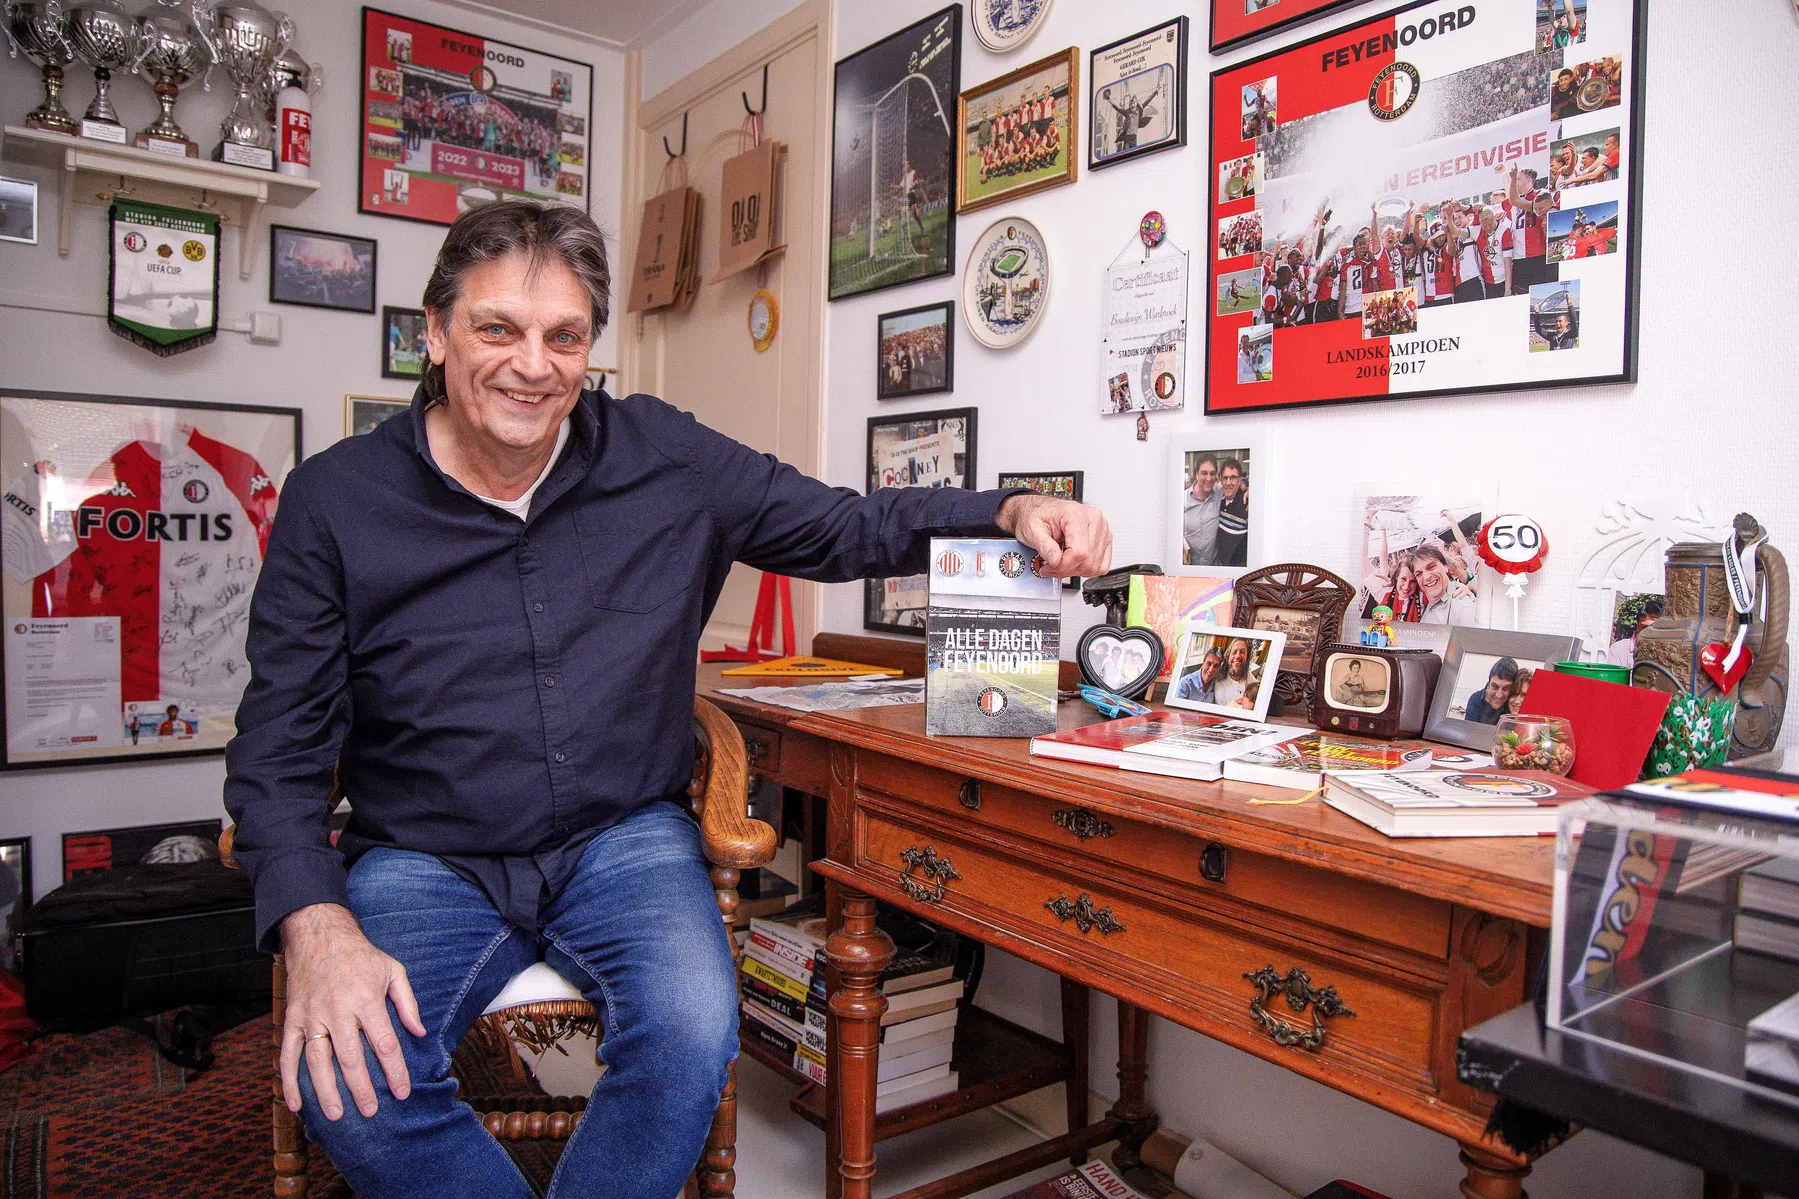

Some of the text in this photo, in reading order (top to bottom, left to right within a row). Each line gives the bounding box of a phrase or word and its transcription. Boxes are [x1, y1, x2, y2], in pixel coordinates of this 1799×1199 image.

[1322, 5, 1477, 73] FEYENOORD
[441, 38, 525, 68] FEYENOORD
[1372, 62, 1417, 89] FEYENOORD
[1371, 93, 1417, 119] ROTTERDAM
[437, 150, 520, 176] 2022 2023
[1406, 130, 1549, 188] EREDIVISIE
[147, 263, 182, 274] UEFA CUP
[1113, 267, 1179, 292] Certificaat
[1118, 347, 1139, 359] STADION
[1326, 336, 1461, 364] LANDSKAMPIOEN
[1355, 360, 1426, 379] 2016/2017
[882, 455, 940, 488] COCKNEY
[3, 491, 37, 518] RTIS
[78, 505, 233, 542] FORTIS
[1490, 524, 1540, 551] 50
[944, 627, 1043, 652] ALLE DAGEN
[943, 650, 1043, 676] FEYENOORD
[773, 943, 807, 968] INSIDE
[770, 1000, 792, 1017] DEAL
[1085, 1163, 1128, 1197] HAND
